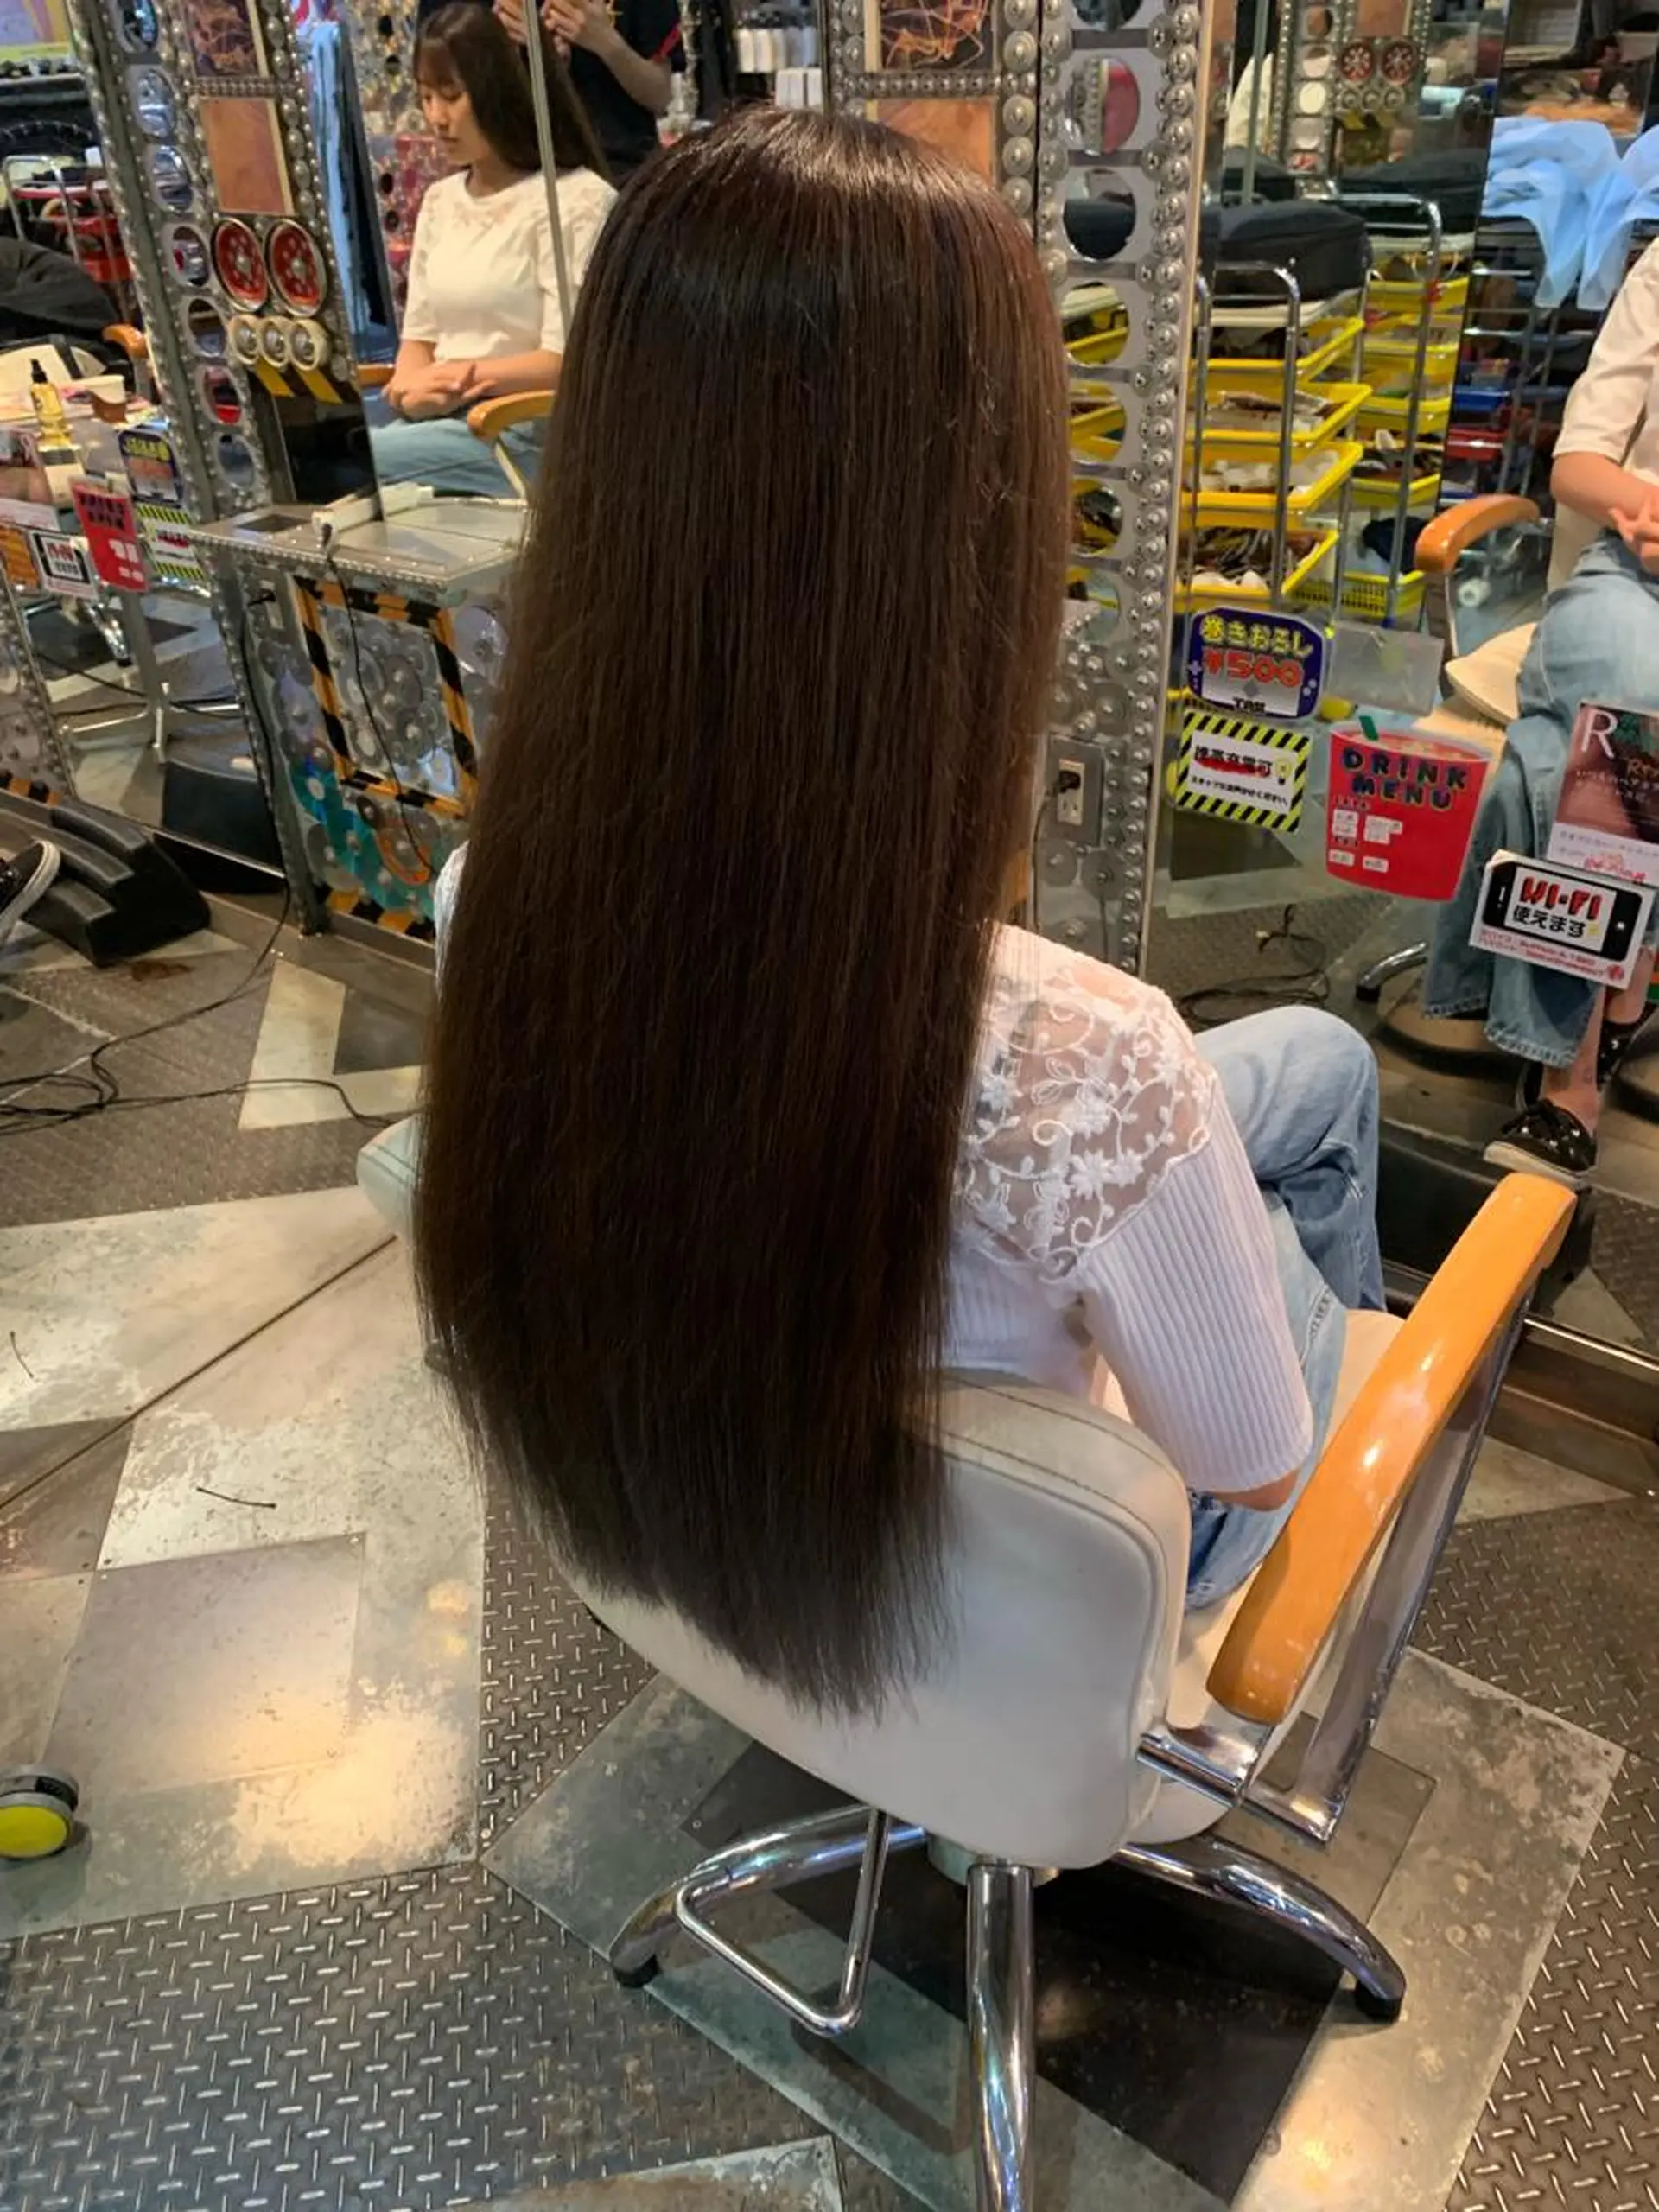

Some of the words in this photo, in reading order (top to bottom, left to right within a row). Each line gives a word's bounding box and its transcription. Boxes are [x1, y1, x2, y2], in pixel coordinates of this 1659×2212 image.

[1343, 746, 1467, 790] DRINK
[1351, 772, 1452, 810] MENU
[1513, 905, 1586, 938] 使えます
